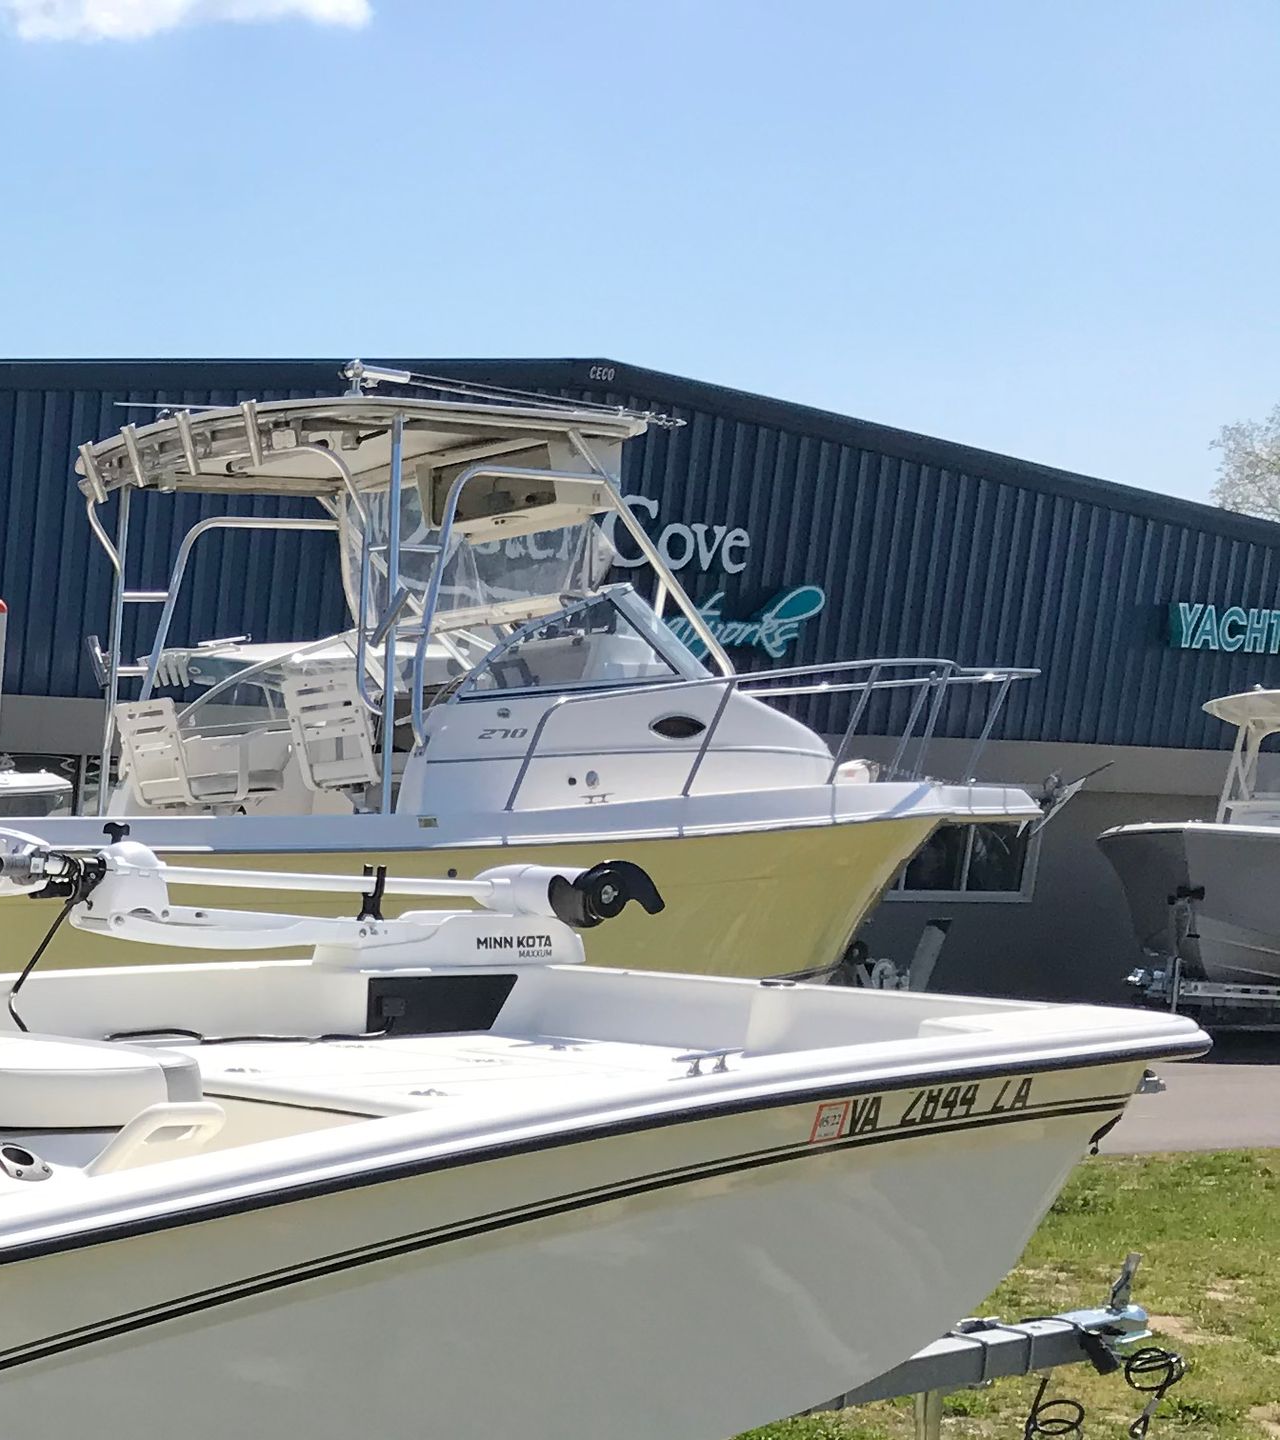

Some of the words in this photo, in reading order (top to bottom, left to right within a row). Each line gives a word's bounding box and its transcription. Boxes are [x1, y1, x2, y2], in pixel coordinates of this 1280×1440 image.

[601, 495, 750, 574] Cove
[478, 728, 528, 740] 270
[476, 936, 513, 950] MINN
[517, 935, 552, 948] KOTA
[518, 949, 552, 958] MAXXUM
[849, 1096, 882, 1137] VA
